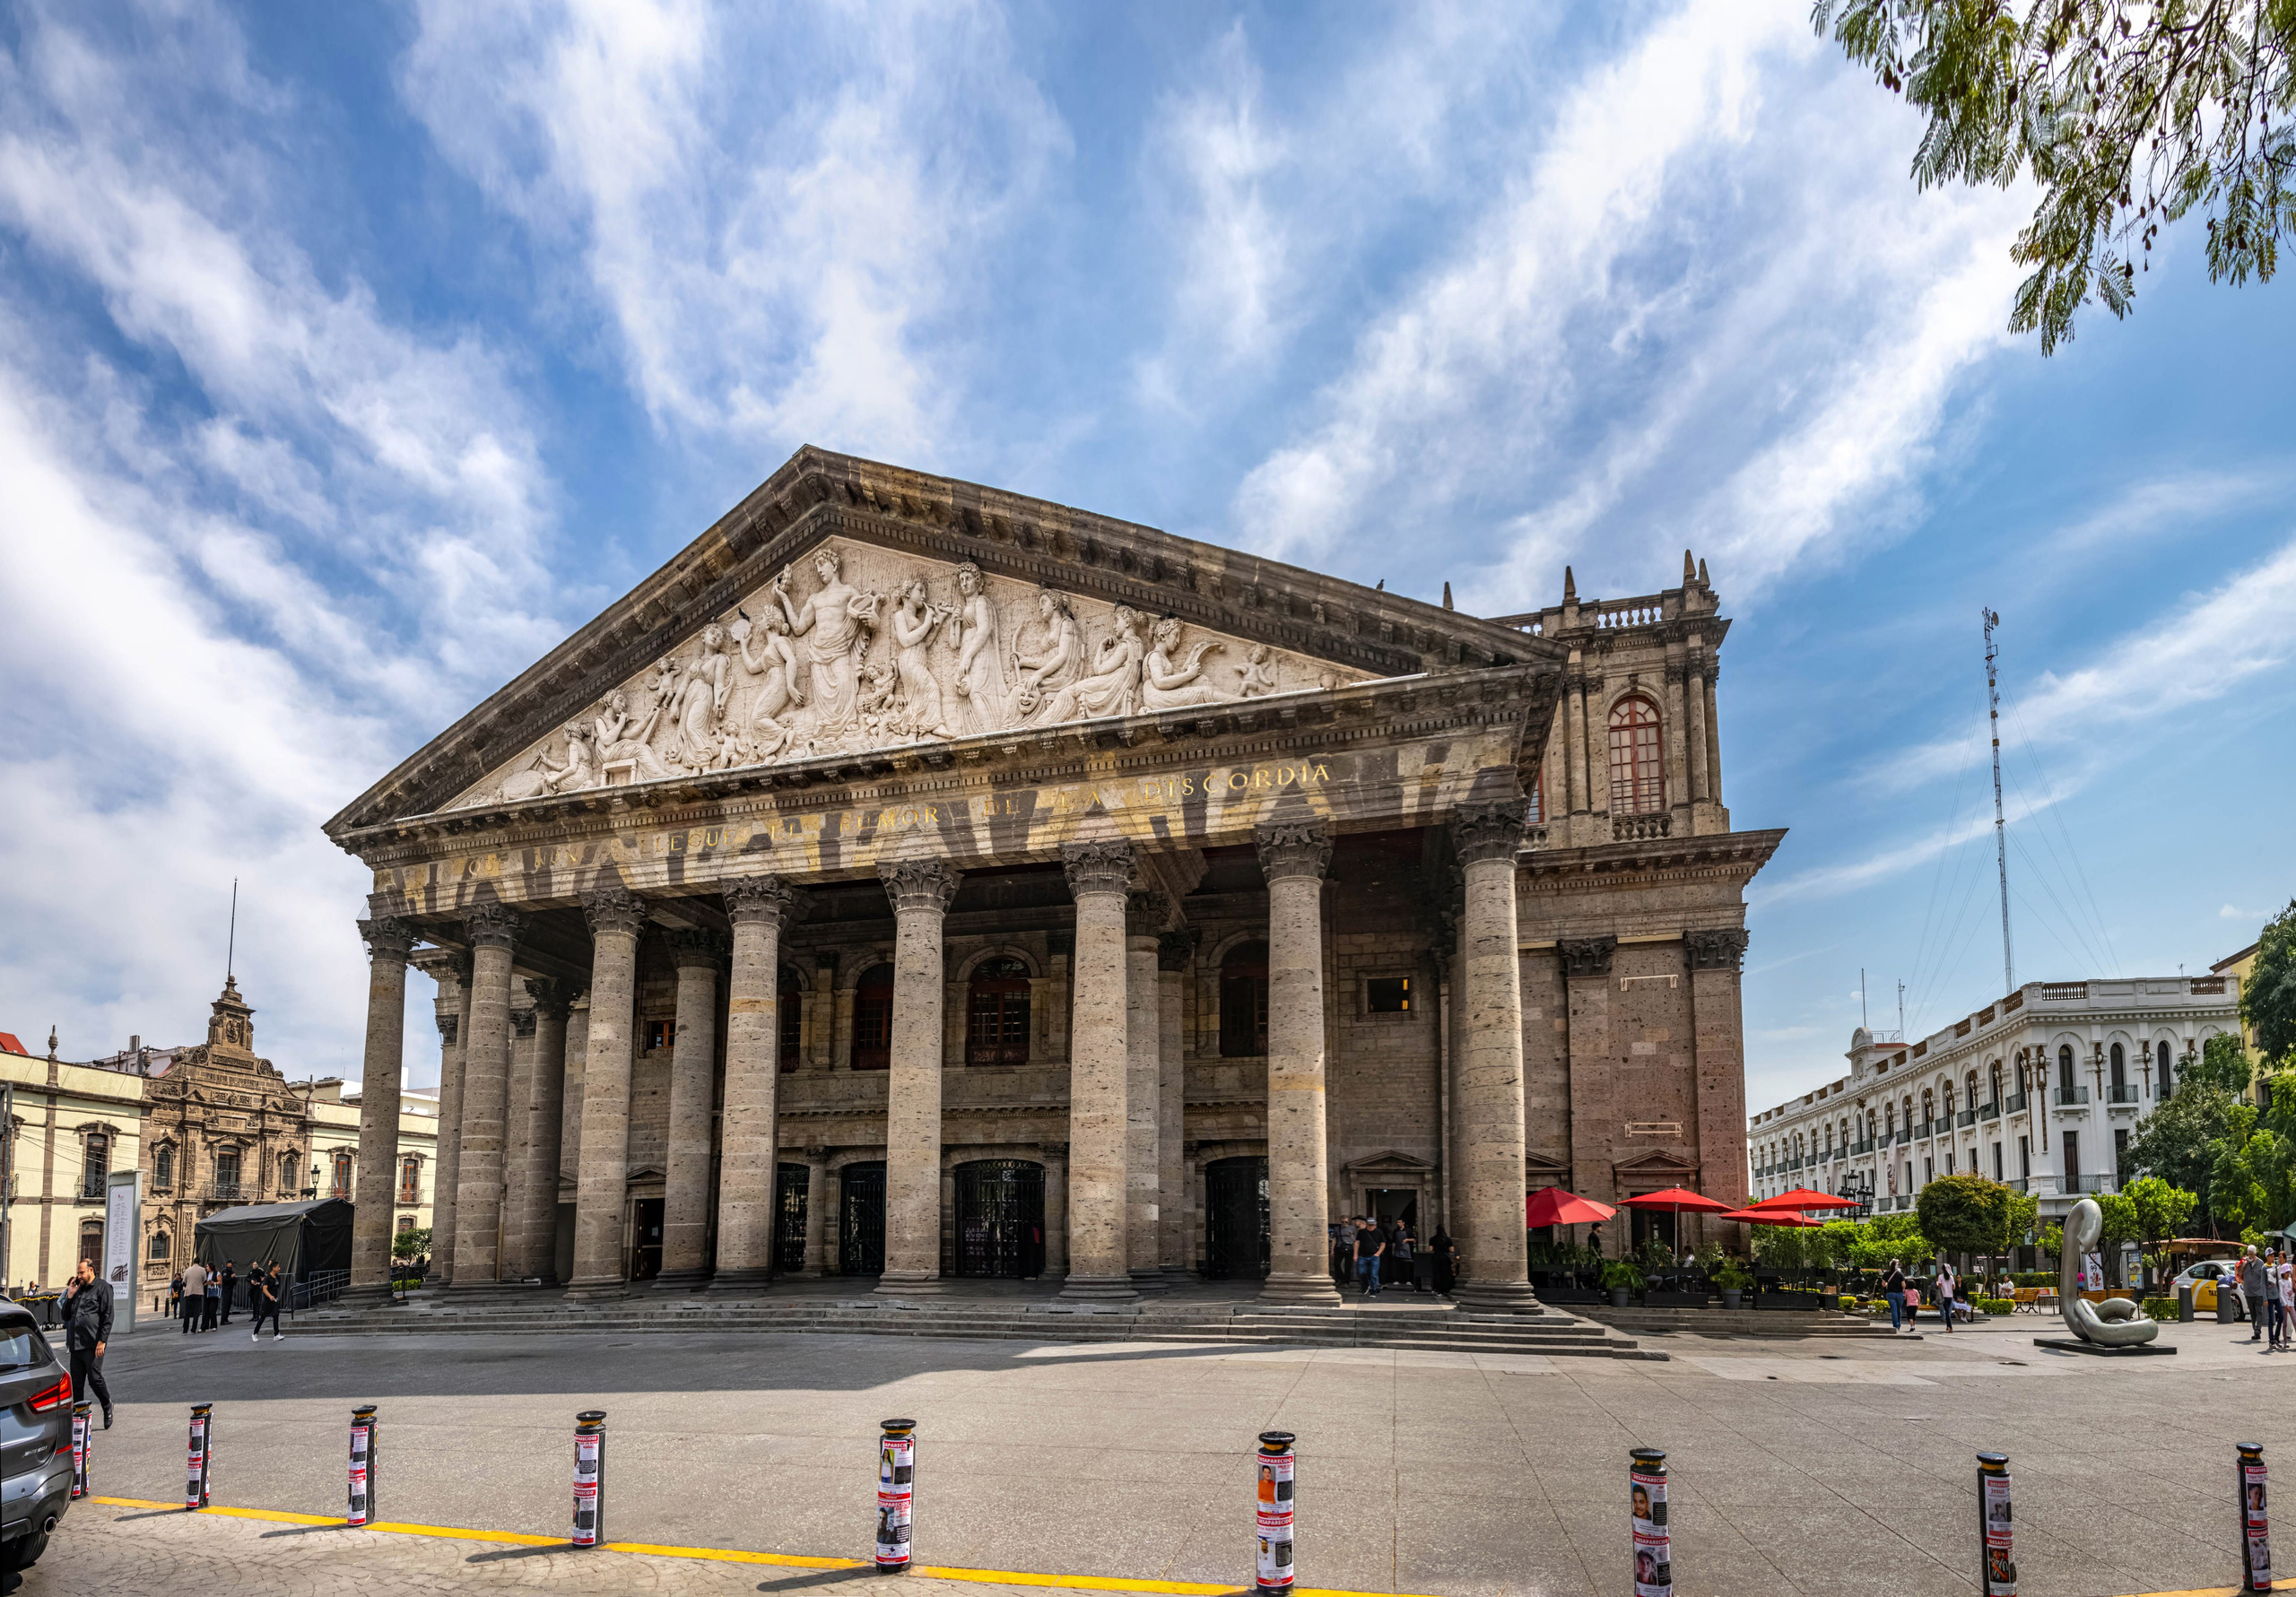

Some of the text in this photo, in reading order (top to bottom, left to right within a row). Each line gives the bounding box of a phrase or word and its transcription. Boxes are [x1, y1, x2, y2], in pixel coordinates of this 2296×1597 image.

[639, 829, 736, 855] LLEGUE
[770, 821, 803, 839] EL
[839, 806, 939, 833] RUMOR
[1061, 790, 1102, 808] LA
[1145, 763, 1330, 800] DISCORDIA
[206, 1072, 228, 1081] PALACIO
[1633, 1473, 1665, 1482] DESAPARECIDO
[1258, 1517, 1292, 1525] DESAPARECIDO
[1636, 1536, 1668, 1544] DESAPARECIDO
